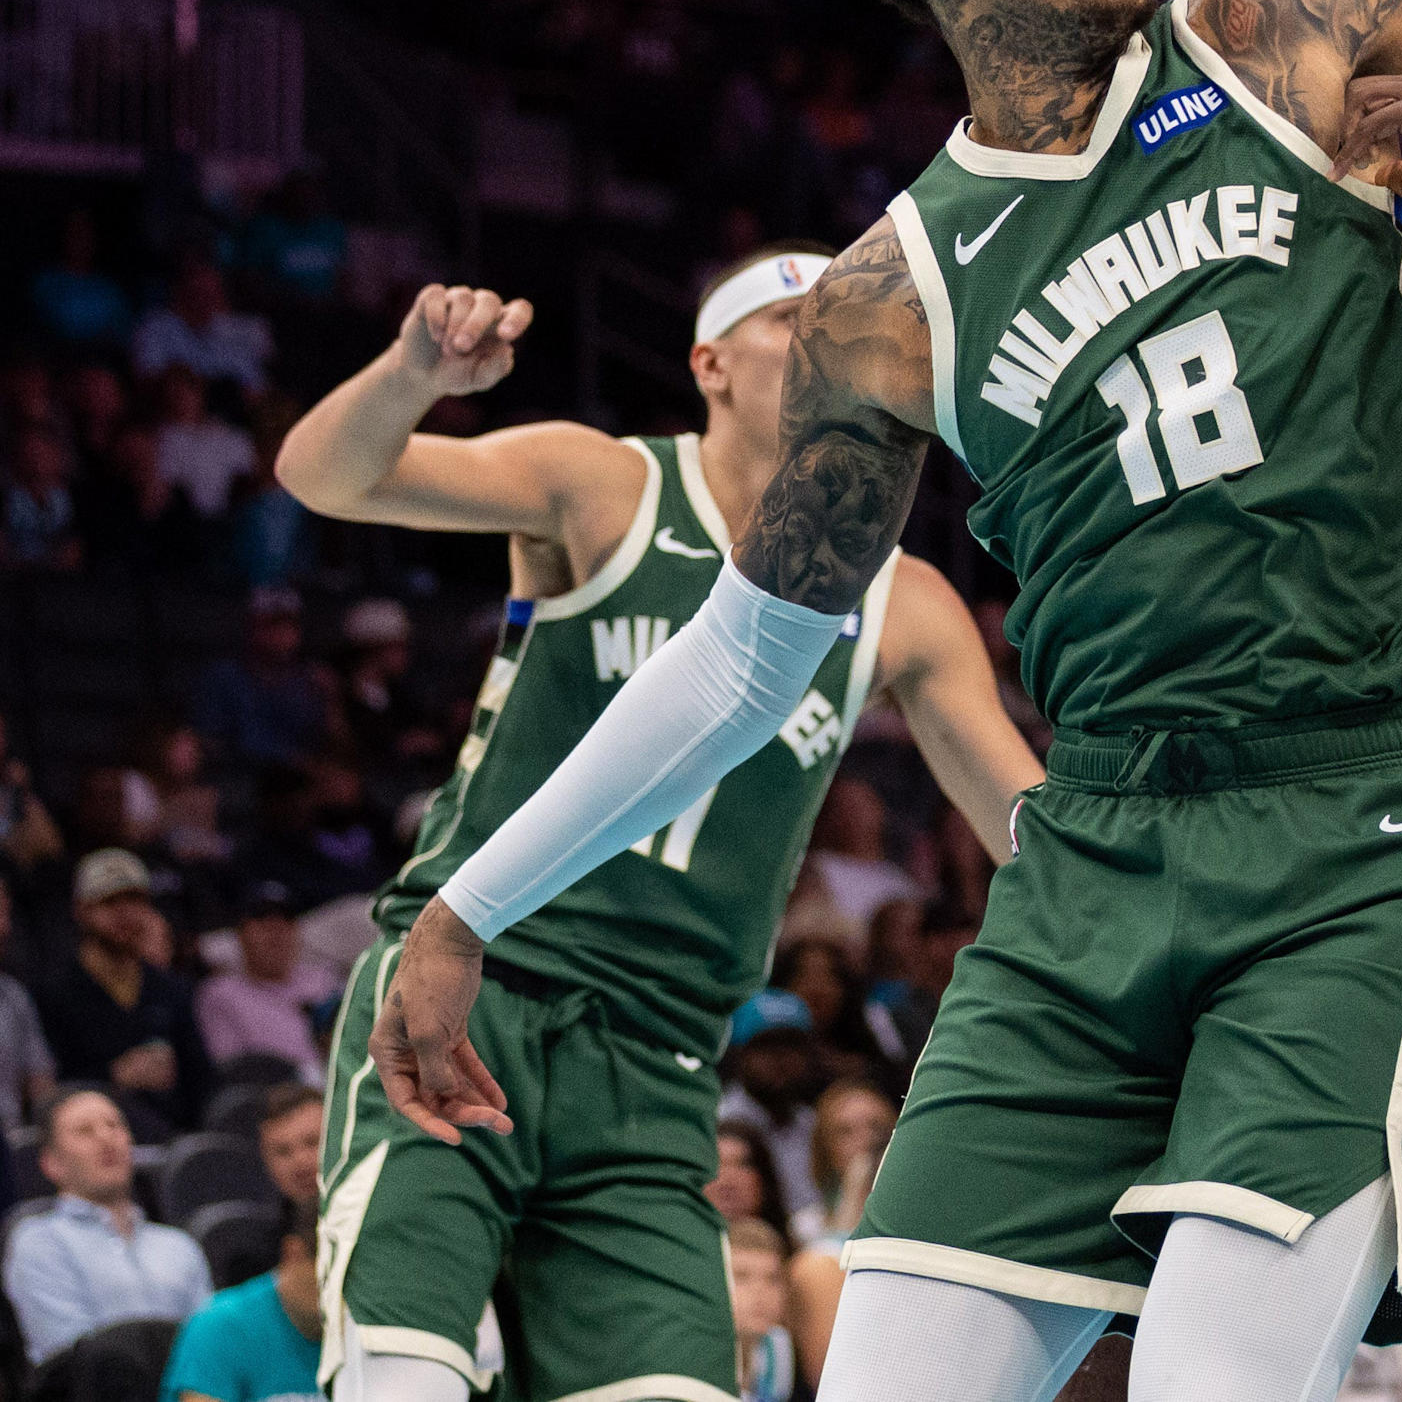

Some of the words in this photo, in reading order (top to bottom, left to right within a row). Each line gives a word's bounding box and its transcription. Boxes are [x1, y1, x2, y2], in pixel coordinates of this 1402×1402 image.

[1138, 85, 1224, 145] ULINE
[980, 184, 1299, 429] MILWAUKEE
[1094, 309, 1265, 506] 18
